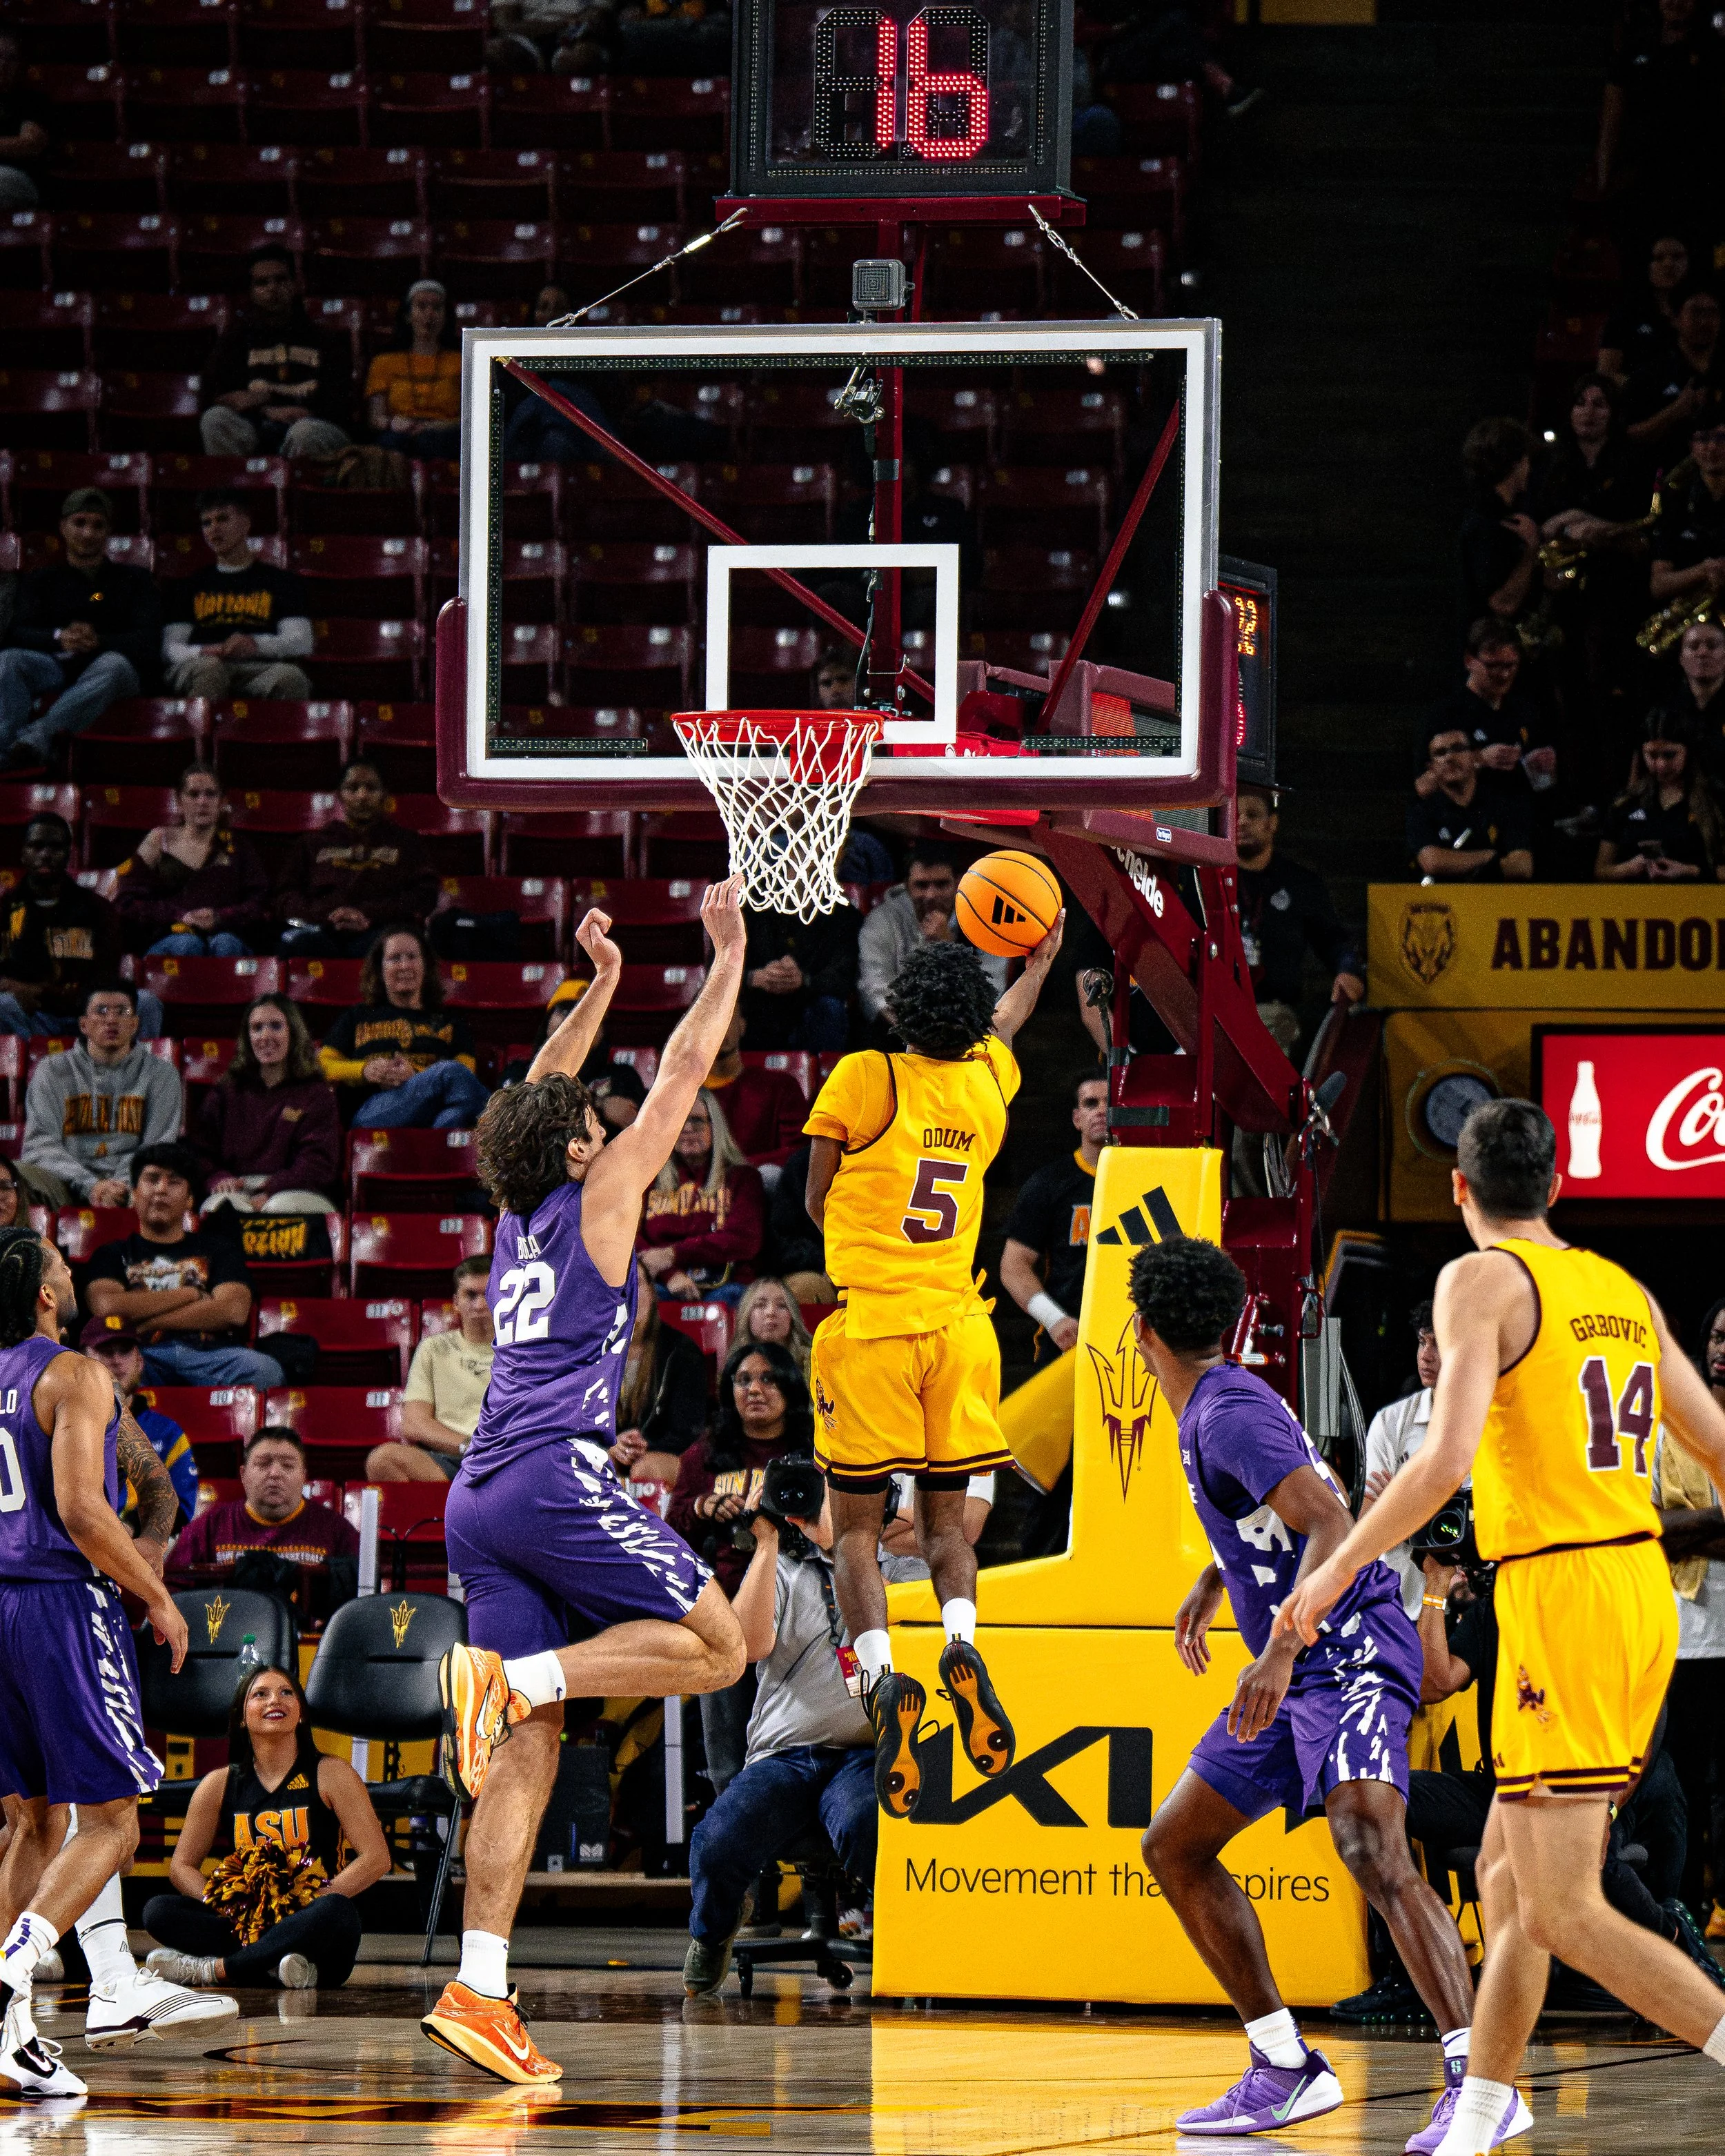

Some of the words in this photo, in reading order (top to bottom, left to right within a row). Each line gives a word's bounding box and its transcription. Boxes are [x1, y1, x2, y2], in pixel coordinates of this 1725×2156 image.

[876, 17, 989, 159] 16
[923, 1128, 976, 1151] ODUM
[1646, 1067, 1725, 1171] Co
[900, 1157, 969, 1244] 5
[493, 1261, 555, 1346] 22
[1569, 1314, 1647, 1349] GRBOVIC
[1577, 1354, 1656, 1478] 14
[286, 1781, 310, 1791] adidas
[233, 1807, 310, 1850] ASU
[905, 1858, 1097, 1895] Movement
[1108, 1862, 1163, 1897] tha
